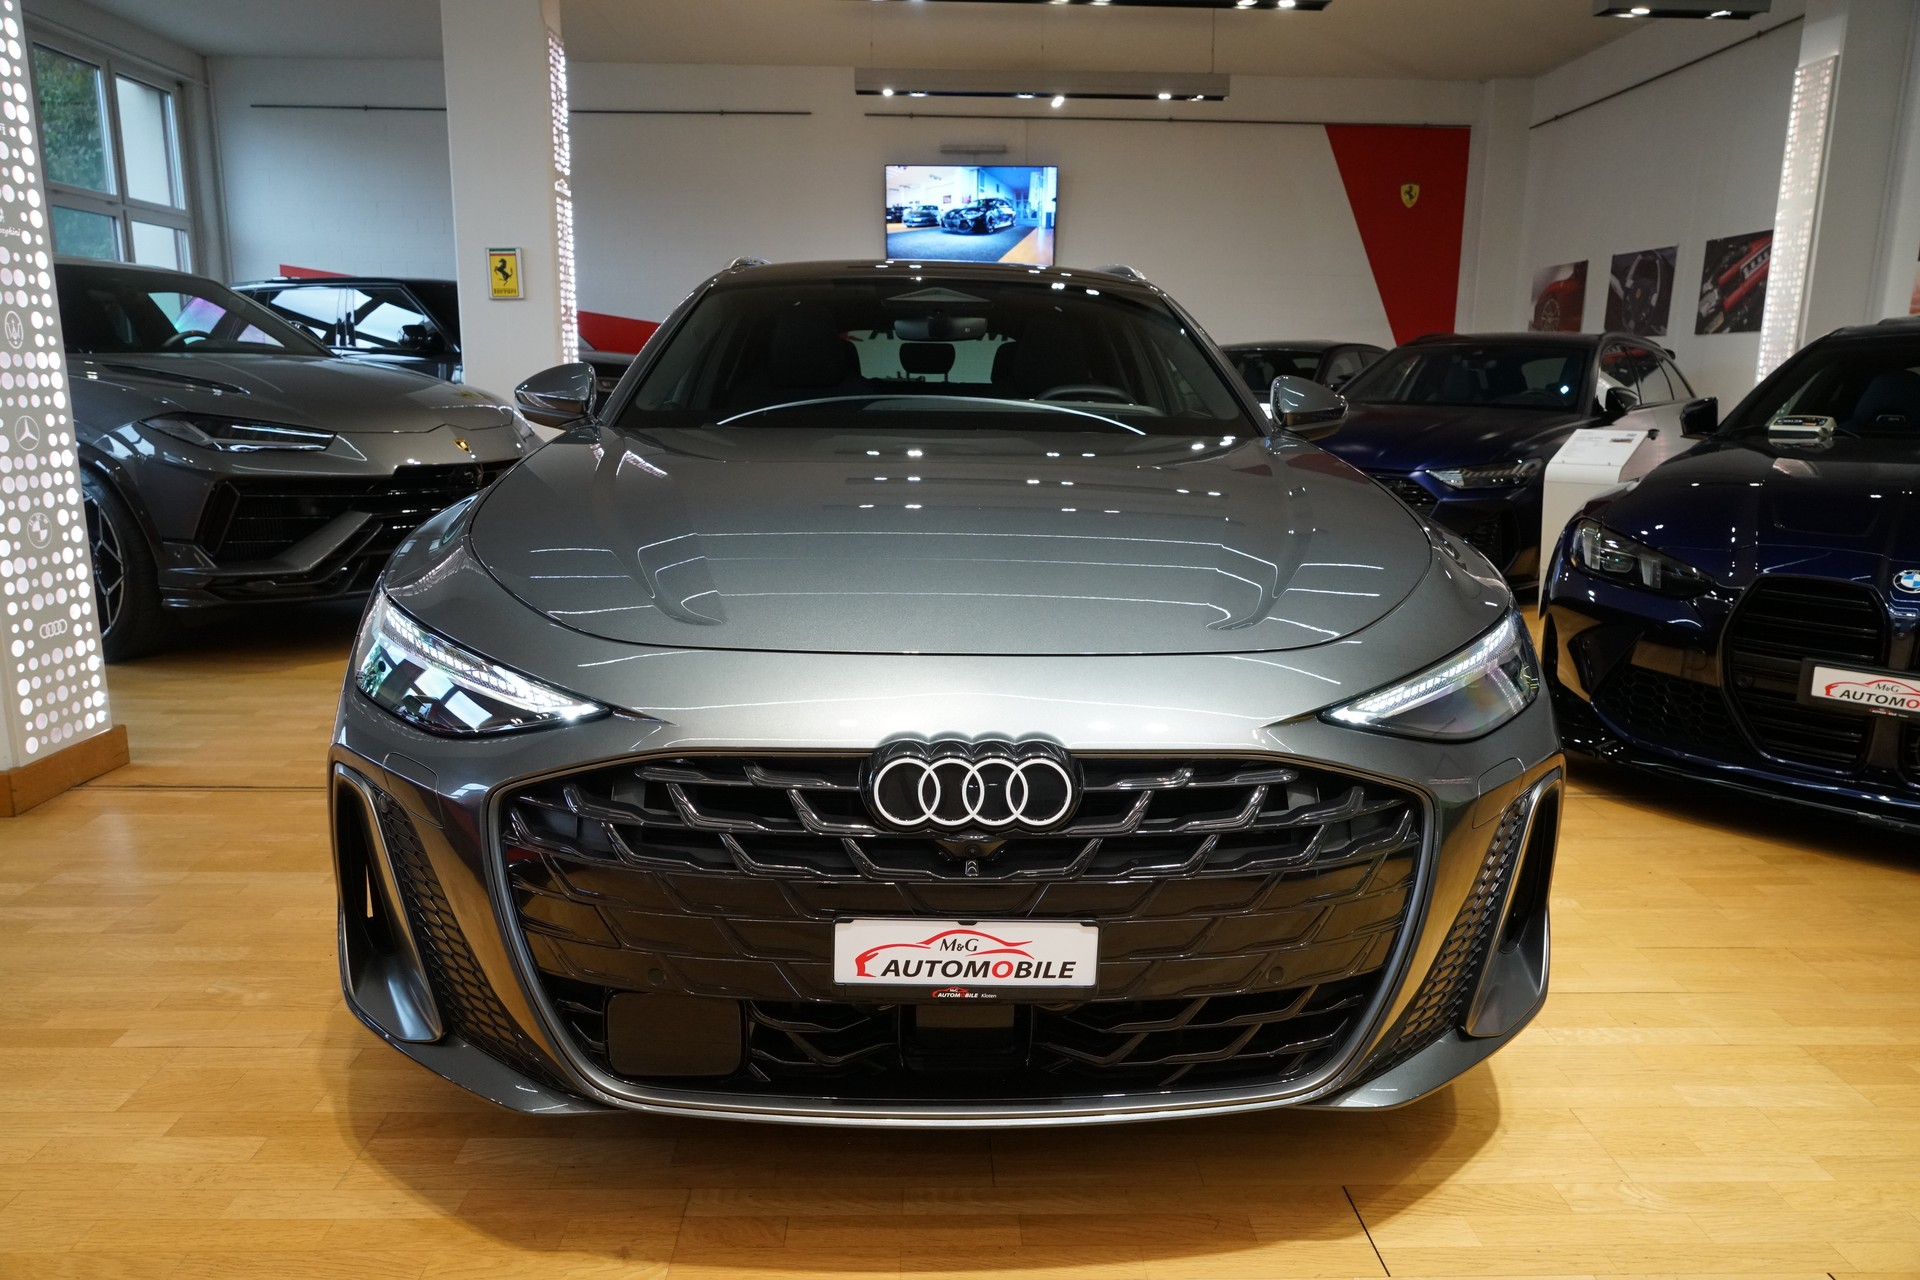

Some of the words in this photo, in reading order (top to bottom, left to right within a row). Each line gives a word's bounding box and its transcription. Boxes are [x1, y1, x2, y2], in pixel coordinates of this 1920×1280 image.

[1839, 689, 1920, 709] AUTOMO
[939, 938, 979, 952] M&G
[881, 959, 1077, 979] AUTOMOBILE
